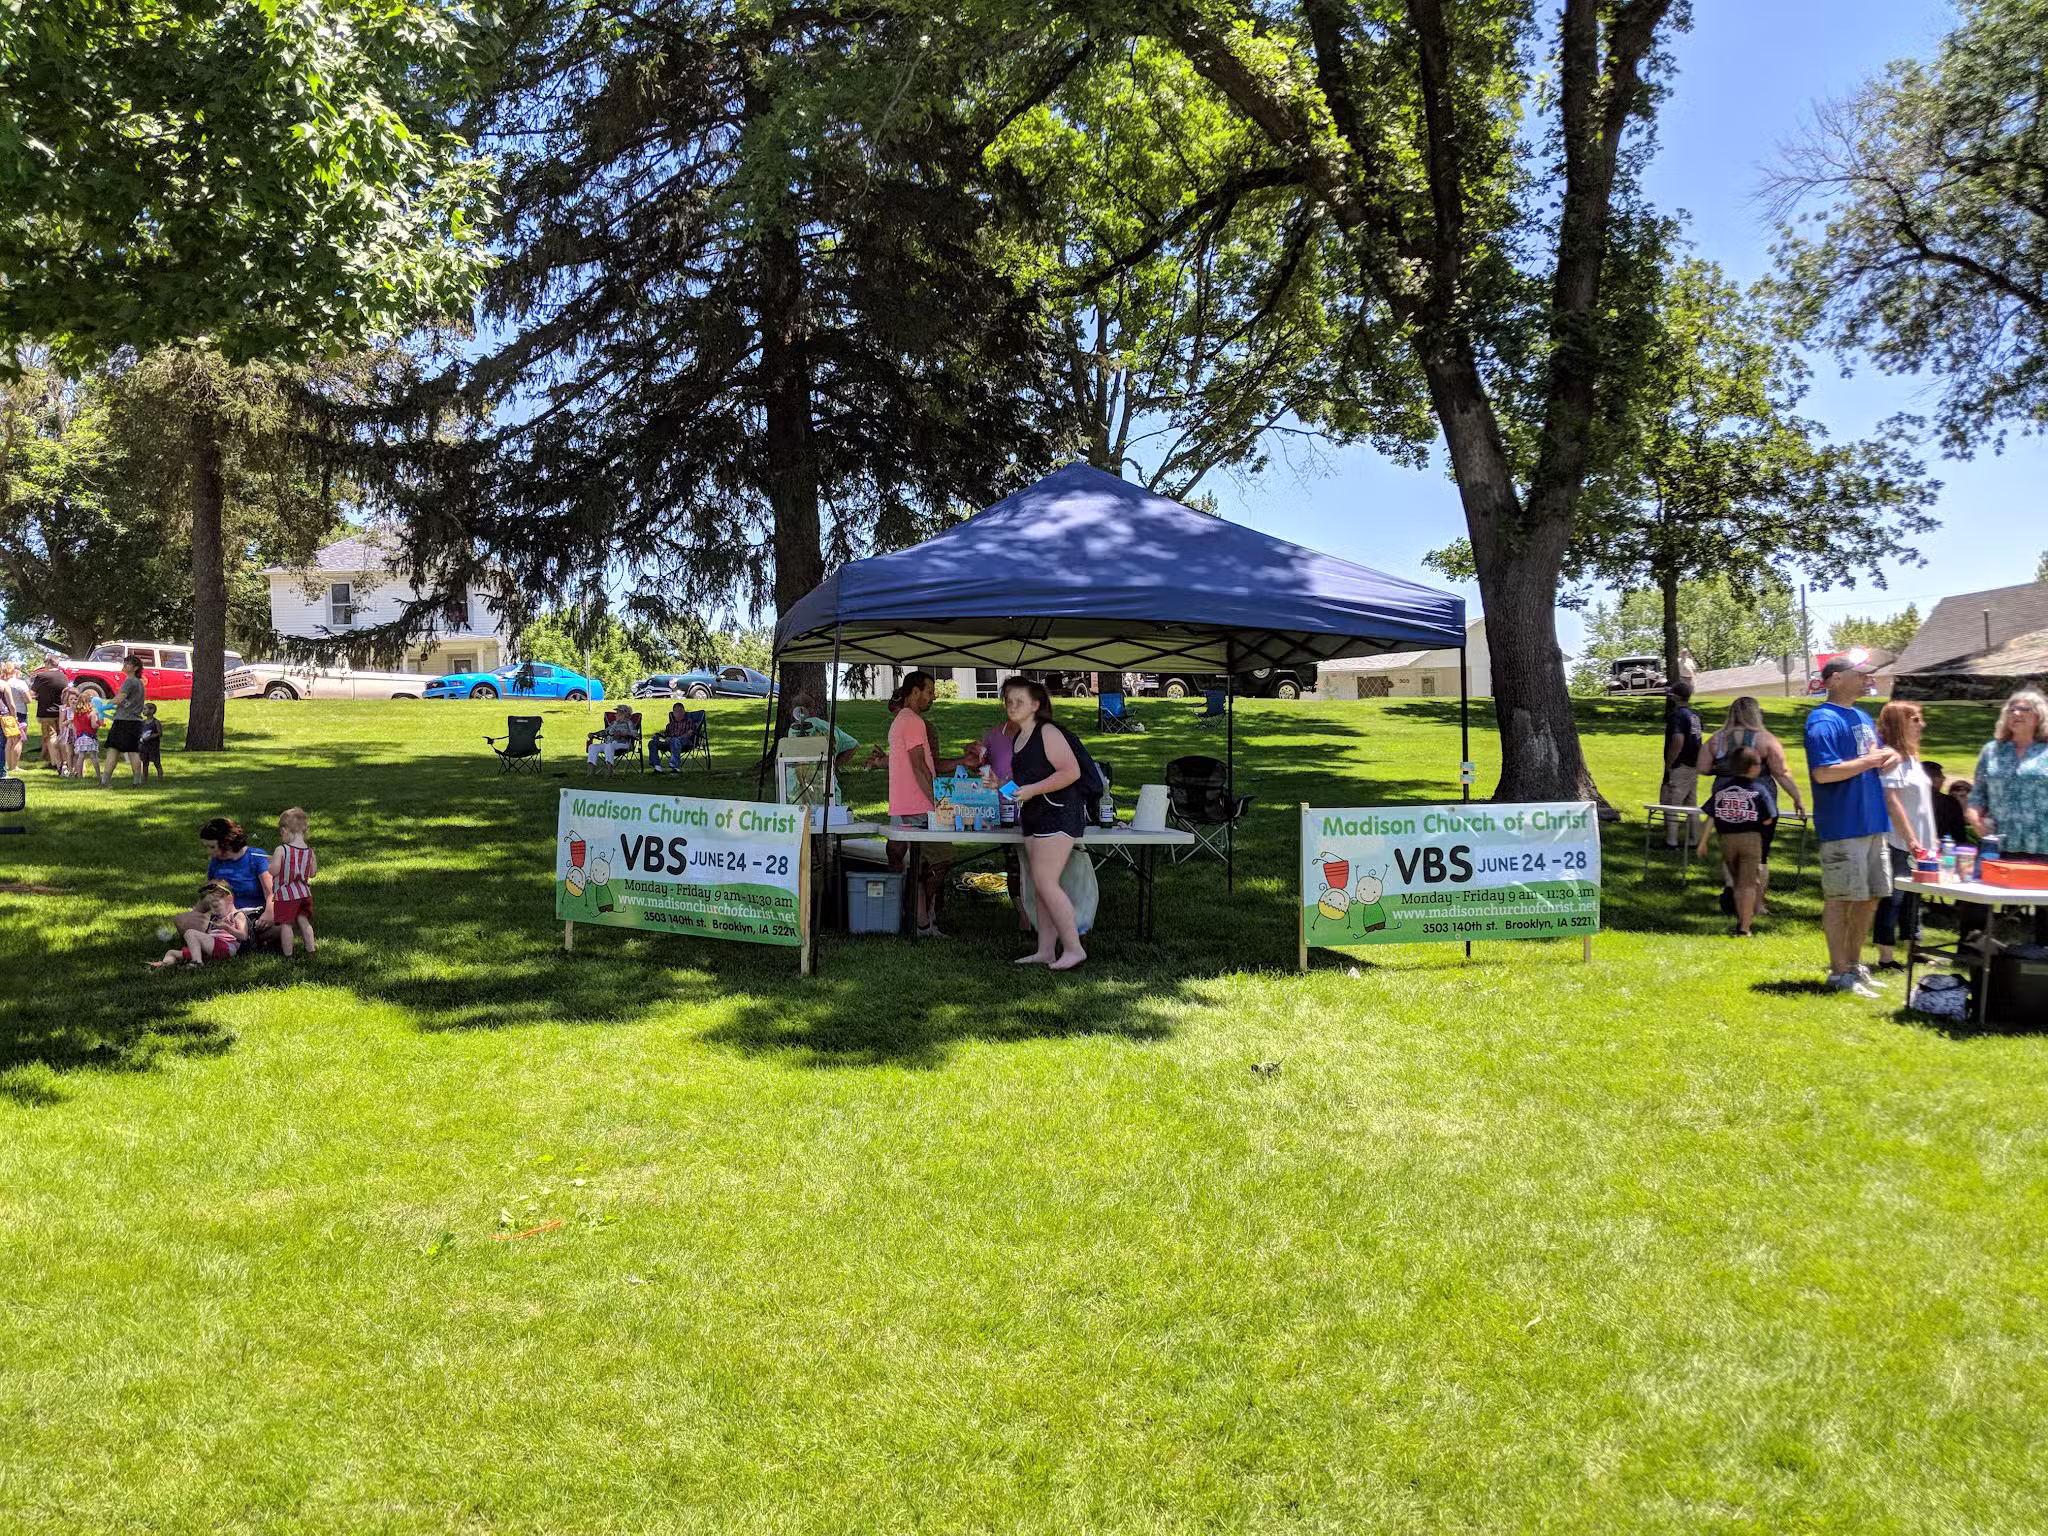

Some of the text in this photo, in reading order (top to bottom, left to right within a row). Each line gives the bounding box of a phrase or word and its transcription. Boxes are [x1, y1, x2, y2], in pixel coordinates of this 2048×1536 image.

[573, 799, 796, 833] Madison Church of Christ
[1715, 807, 1758, 821] RESCUE
[1722, 799, 1749, 809] FIRE
[1323, 810, 1588, 836] Madison Church of Christ
[620, 834, 687, 875] VBS
[690, 852, 723, 867] JUNE
[727, 852, 746, 871] 24
[766, 855, 788, 875] 28
[1394, 845, 1473, 884] VBS
[1478, 857, 1518, 873] JUNE
[1522, 853, 1546, 872] 24
[1564, 851, 1586, 869] 28
[625, 879, 668, 896] Monday
[677, 884, 710, 901] Friday
[714, 891, 722, 901] 9
[748, 895, 771, 906] 11:30
[775, 898, 792, 907] am
[1401, 893, 1452, 906] Monday
[1464, 890, 1504, 903] Friday
[1509, 892, 1516, 902] 9
[1546, 889, 1574, 899] 11:30
[1577, 888, 1594, 897] am
[618, 894, 796, 922] www.madisonchurchofchrist.net
[1392, 902, 1597, 919] www.madisonchurchofchrist.net
[644, 912, 666, 923] 3503
[670, 914, 693, 926] 140th
[694, 918, 706, 927] st.
[713, 920, 756, 934] Brooklyn,
[760, 924, 769, 934] IA
[1423, 923, 1448, 932] 3503
[1452, 922, 1482, 932] 140th
[1485, 922, 1498, 930] st.
[1505, 919, 1553, 930] Brooklyn,
[1557, 917, 1568, 927] IA
